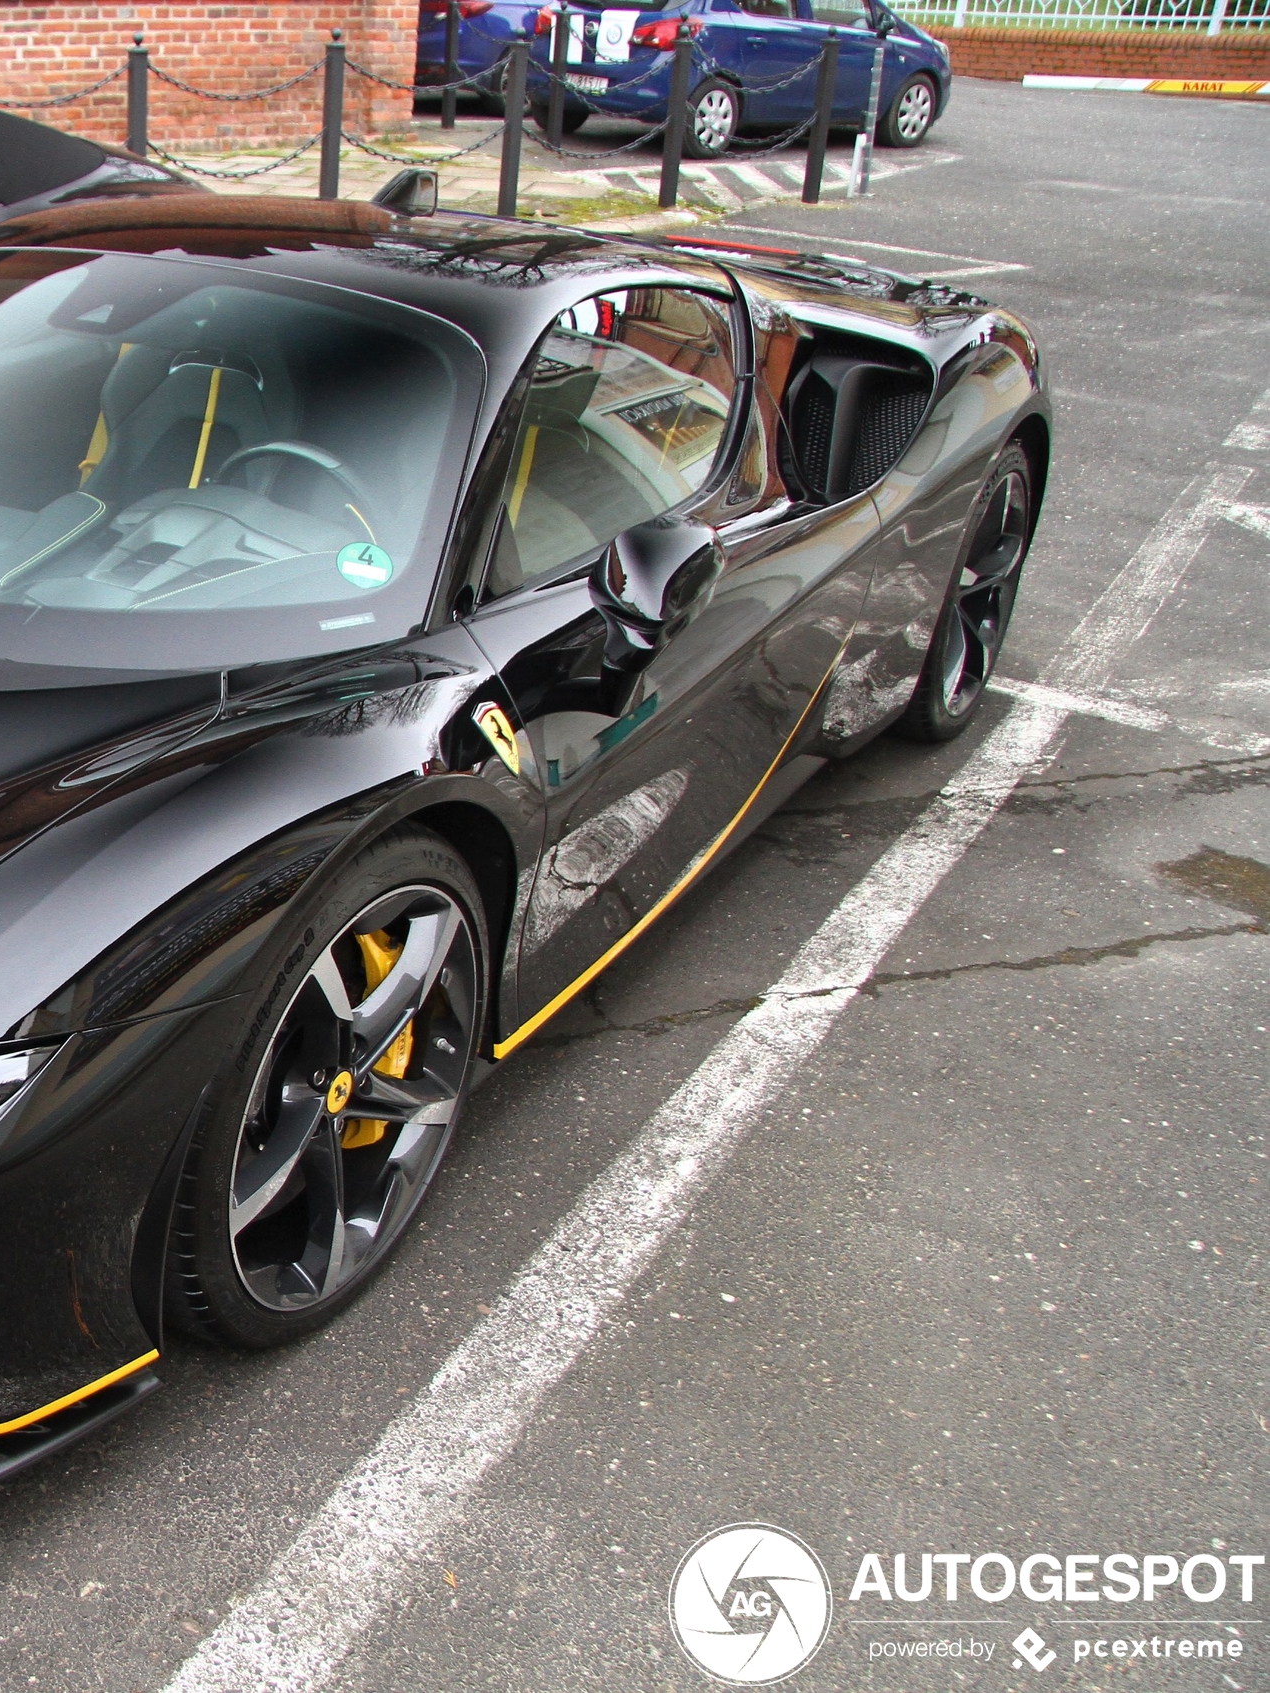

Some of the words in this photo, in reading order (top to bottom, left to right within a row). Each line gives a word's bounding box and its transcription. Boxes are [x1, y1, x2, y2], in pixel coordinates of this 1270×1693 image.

[1182, 82, 1225, 91] KARAT
[357, 545, 374, 566] 4
[284, 943, 306, 975] Cup
[304, 926, 316, 947] 2
